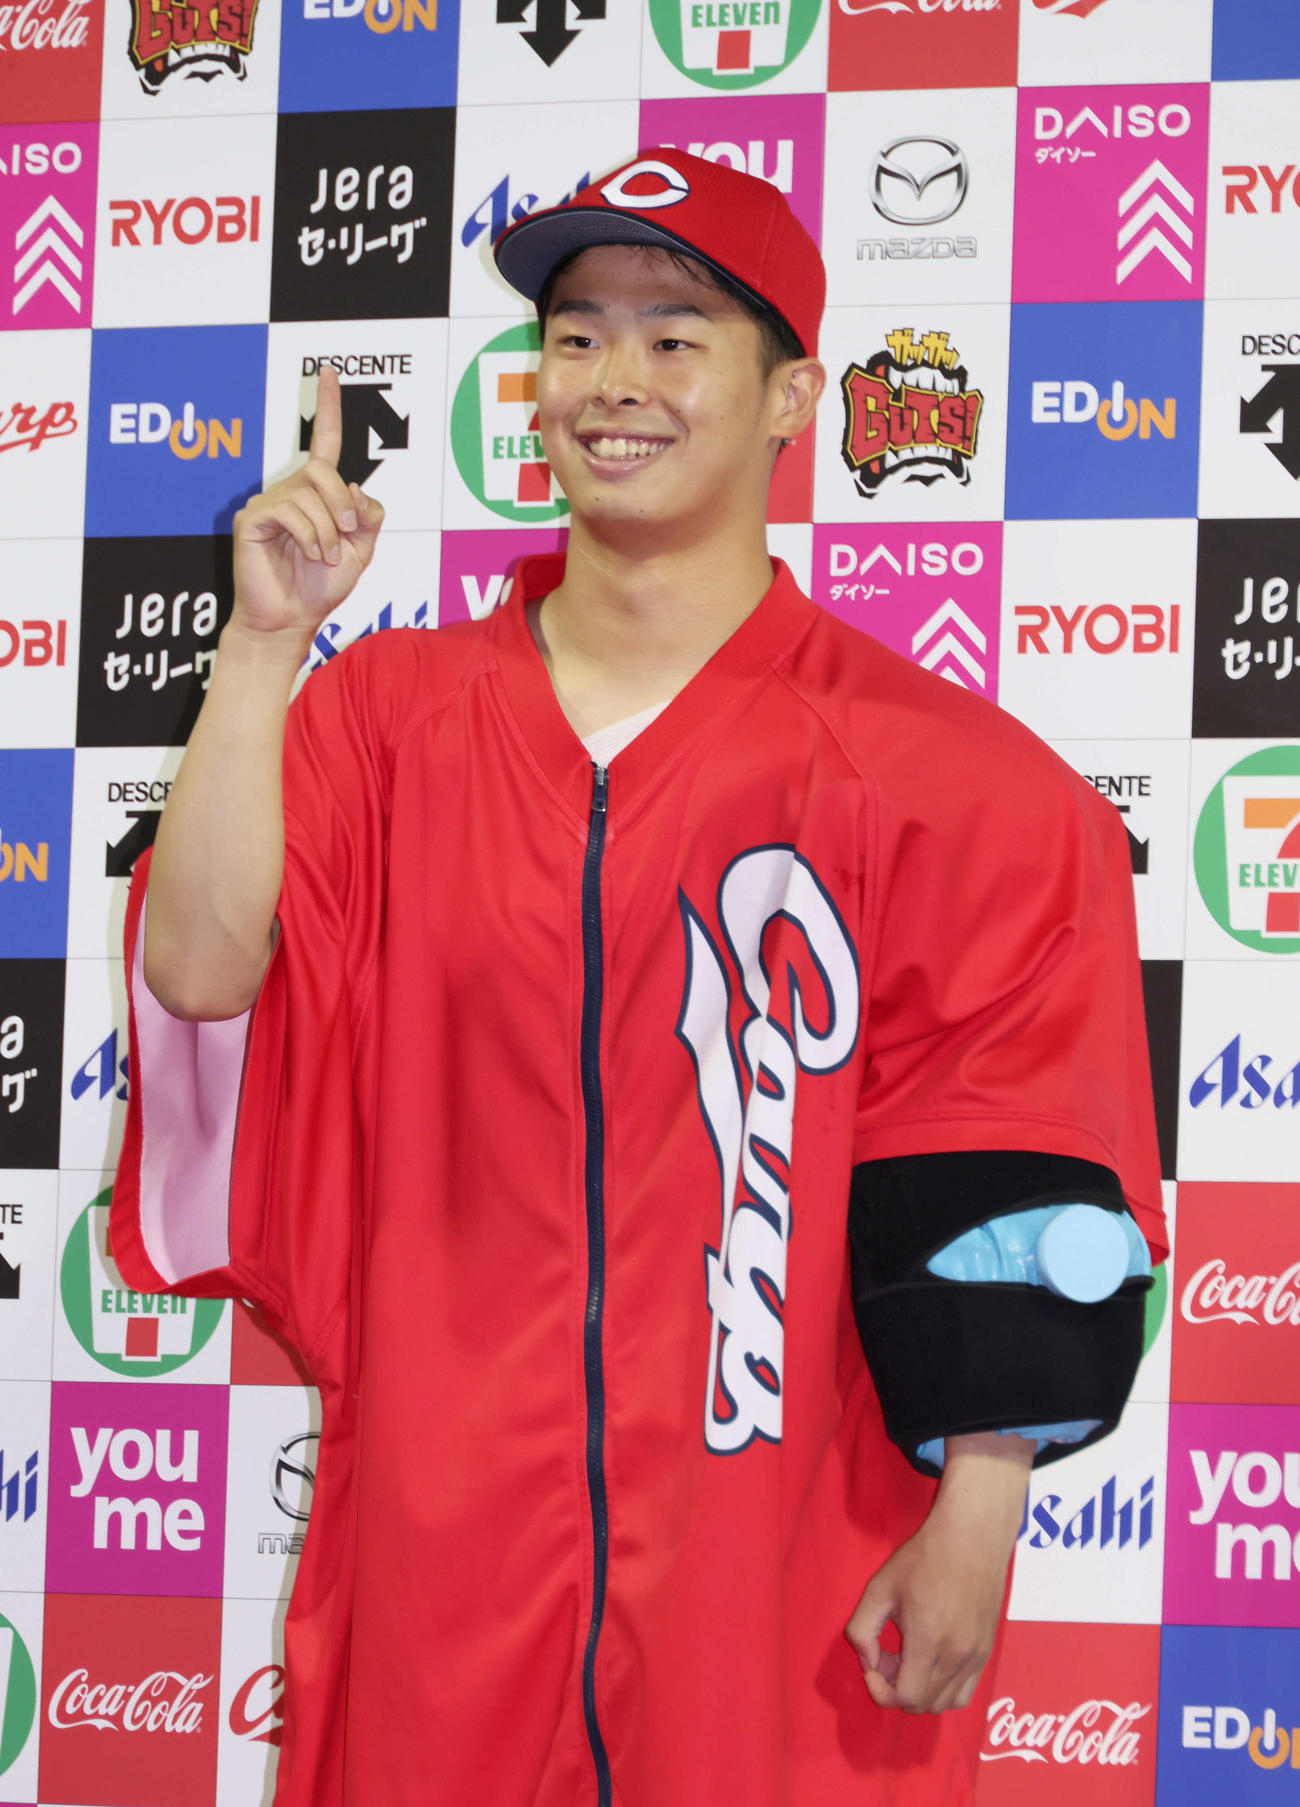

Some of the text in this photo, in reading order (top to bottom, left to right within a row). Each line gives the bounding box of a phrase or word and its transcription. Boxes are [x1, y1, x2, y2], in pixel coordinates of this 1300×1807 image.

[1034, 103, 1191, 140] DAISO
[0, 141, 83, 176] ISO
[1034, 145, 1097, 164] ダイソー
[1222, 164, 1300, 215] RY
[109, 195, 260, 247] RYOBI
[109, 401, 243, 460] EDION
[842, 366, 984, 469] GUTS!
[1031, 380, 1177, 441] EDION
[829, 542, 984, 577] DAISO
[829, 584, 890, 600] ダイソー
[1234, 576, 1300, 625] Je
[1014, 603, 1181, 655] RYOBI
[1221, 636, 1300, 681] セ・リ
[70, 1427, 199, 1498] you
[93, 1496, 205, 1551] me
[1017, 1474, 1155, 1550] sahi
[1214, 1522, 1300, 1580] m
[48, 1668, 215, 1734] Coca-Cola
[1182, 1705, 1300, 1770] EDIO
